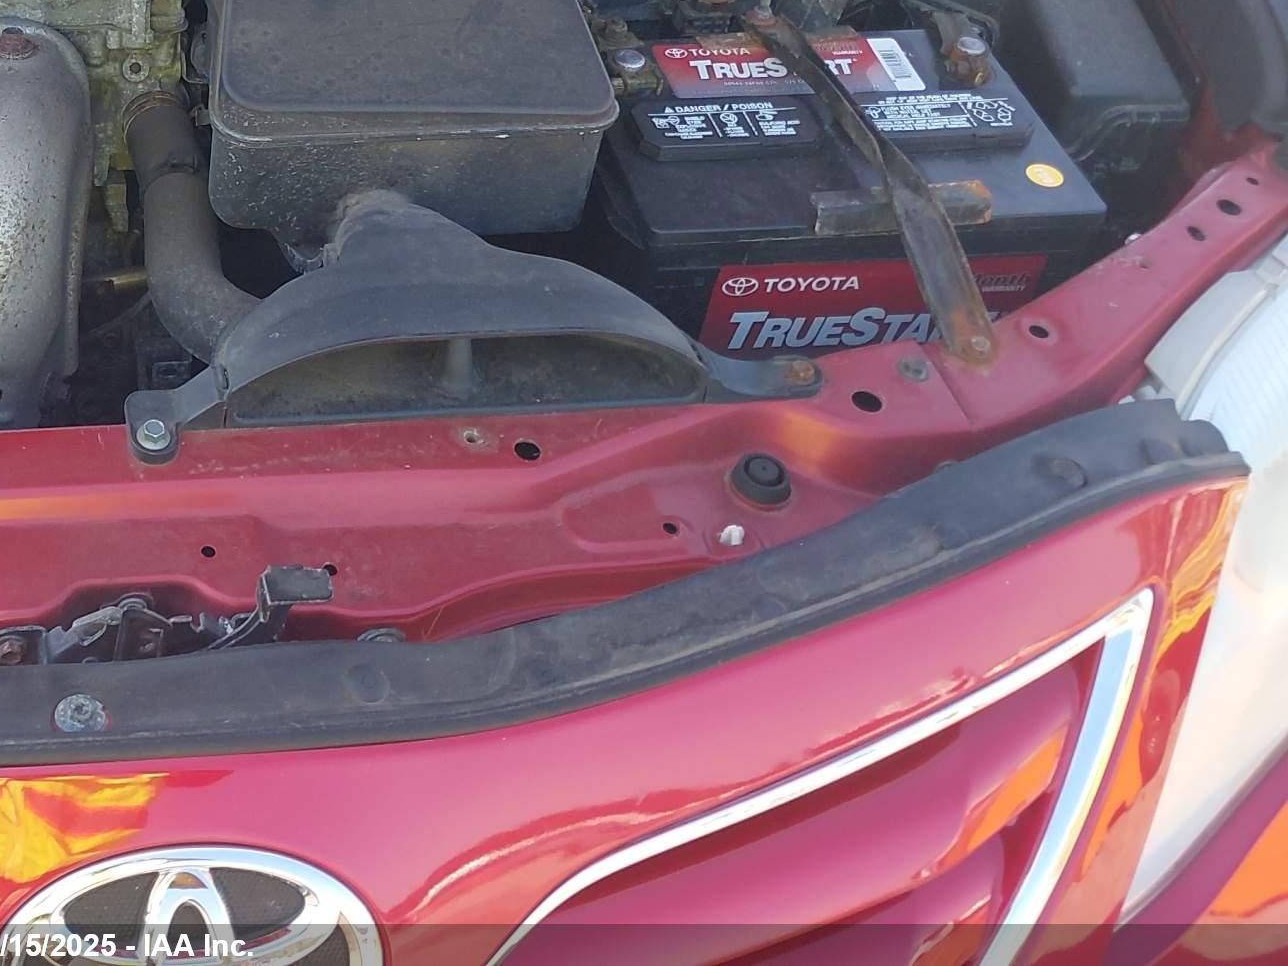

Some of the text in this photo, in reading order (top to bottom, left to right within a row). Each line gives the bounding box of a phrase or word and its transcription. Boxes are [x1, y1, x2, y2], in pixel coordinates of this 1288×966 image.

[689, 47, 751, 57] TOYOTA
[675, 104, 721, 114] DANGER
[732, 101, 773, 111] POISON
[764, 276, 860, 293] TOYOTA
